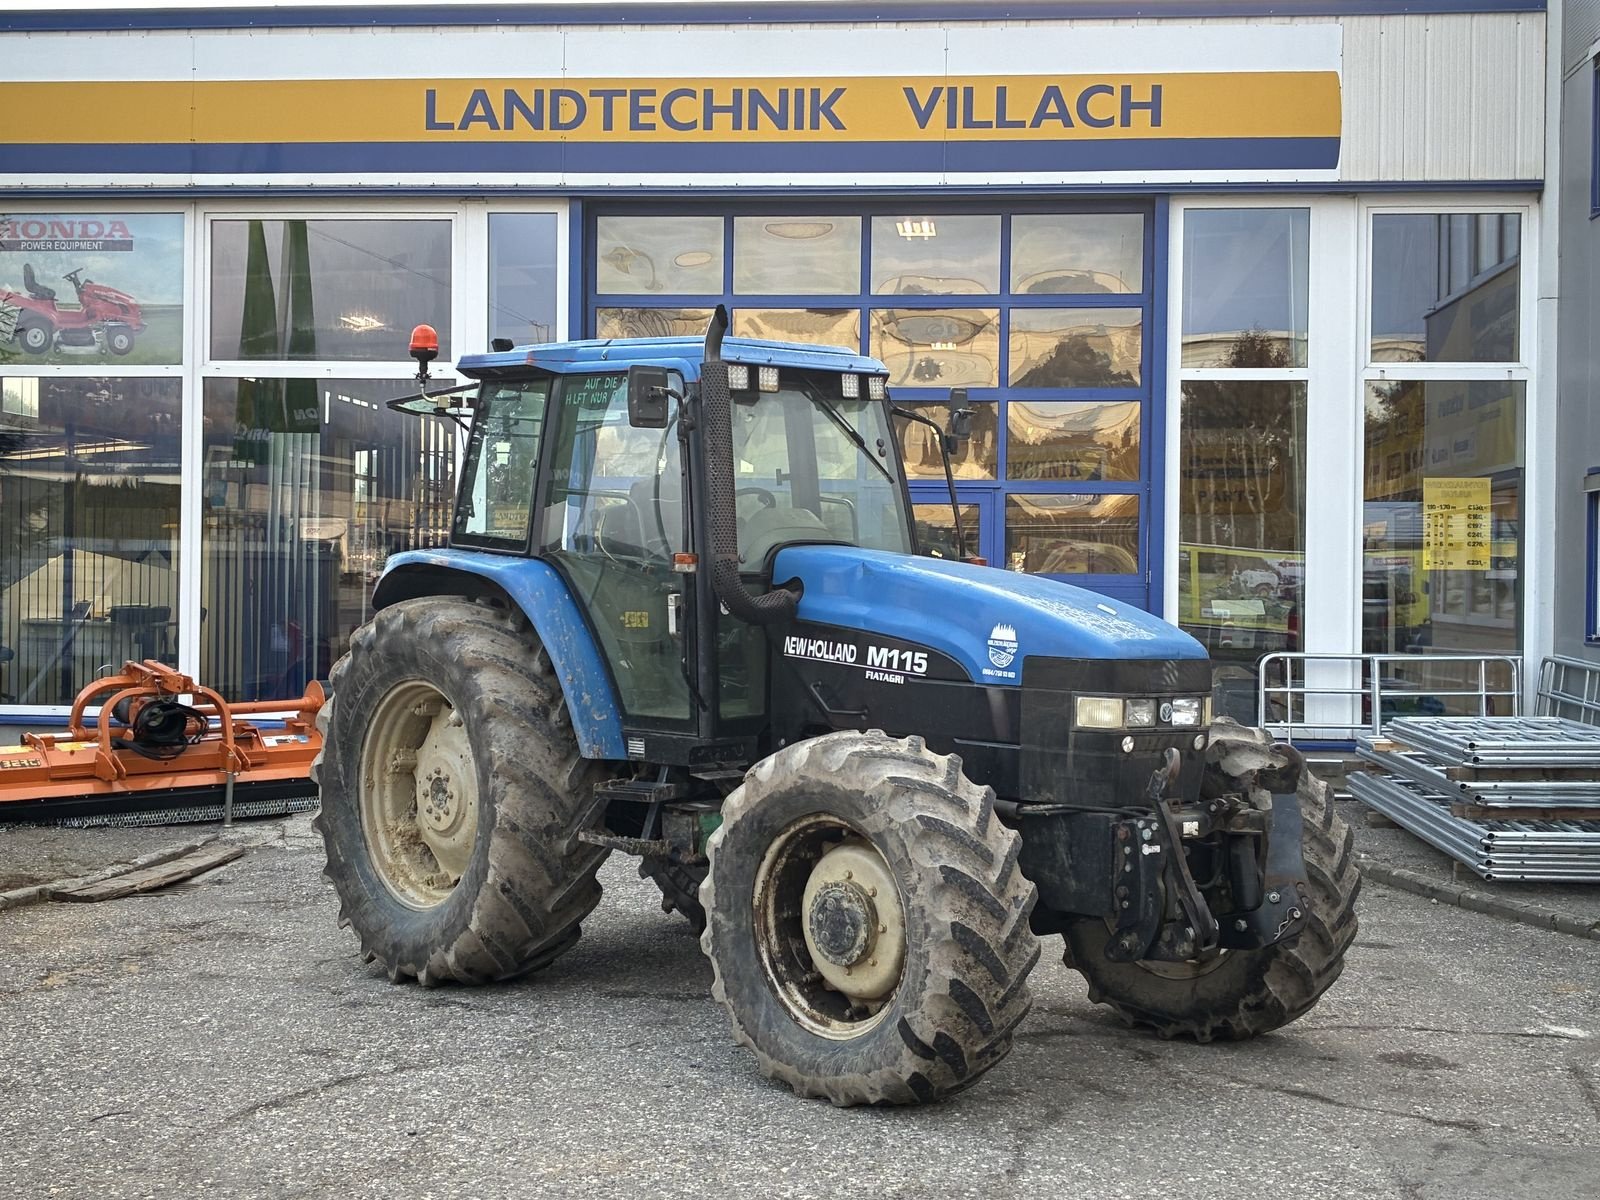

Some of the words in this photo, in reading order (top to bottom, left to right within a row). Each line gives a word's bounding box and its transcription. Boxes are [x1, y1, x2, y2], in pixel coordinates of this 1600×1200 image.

[425, 87, 847, 132] LANDTECHNIK
[902, 84, 1163, 129] VILLACH
[21, 241, 53, 250] POWER
[54, 241, 104, 250] EQUIPMENT
[604, 376, 618, 389] DIE
[590, 391, 608, 404] NUR
[784, 636, 807, 655] NEW
[807, 639, 857, 663] HOLLAND
[866, 646, 928, 673] M115
[865, 670, 905, 685] FIATAGRI
